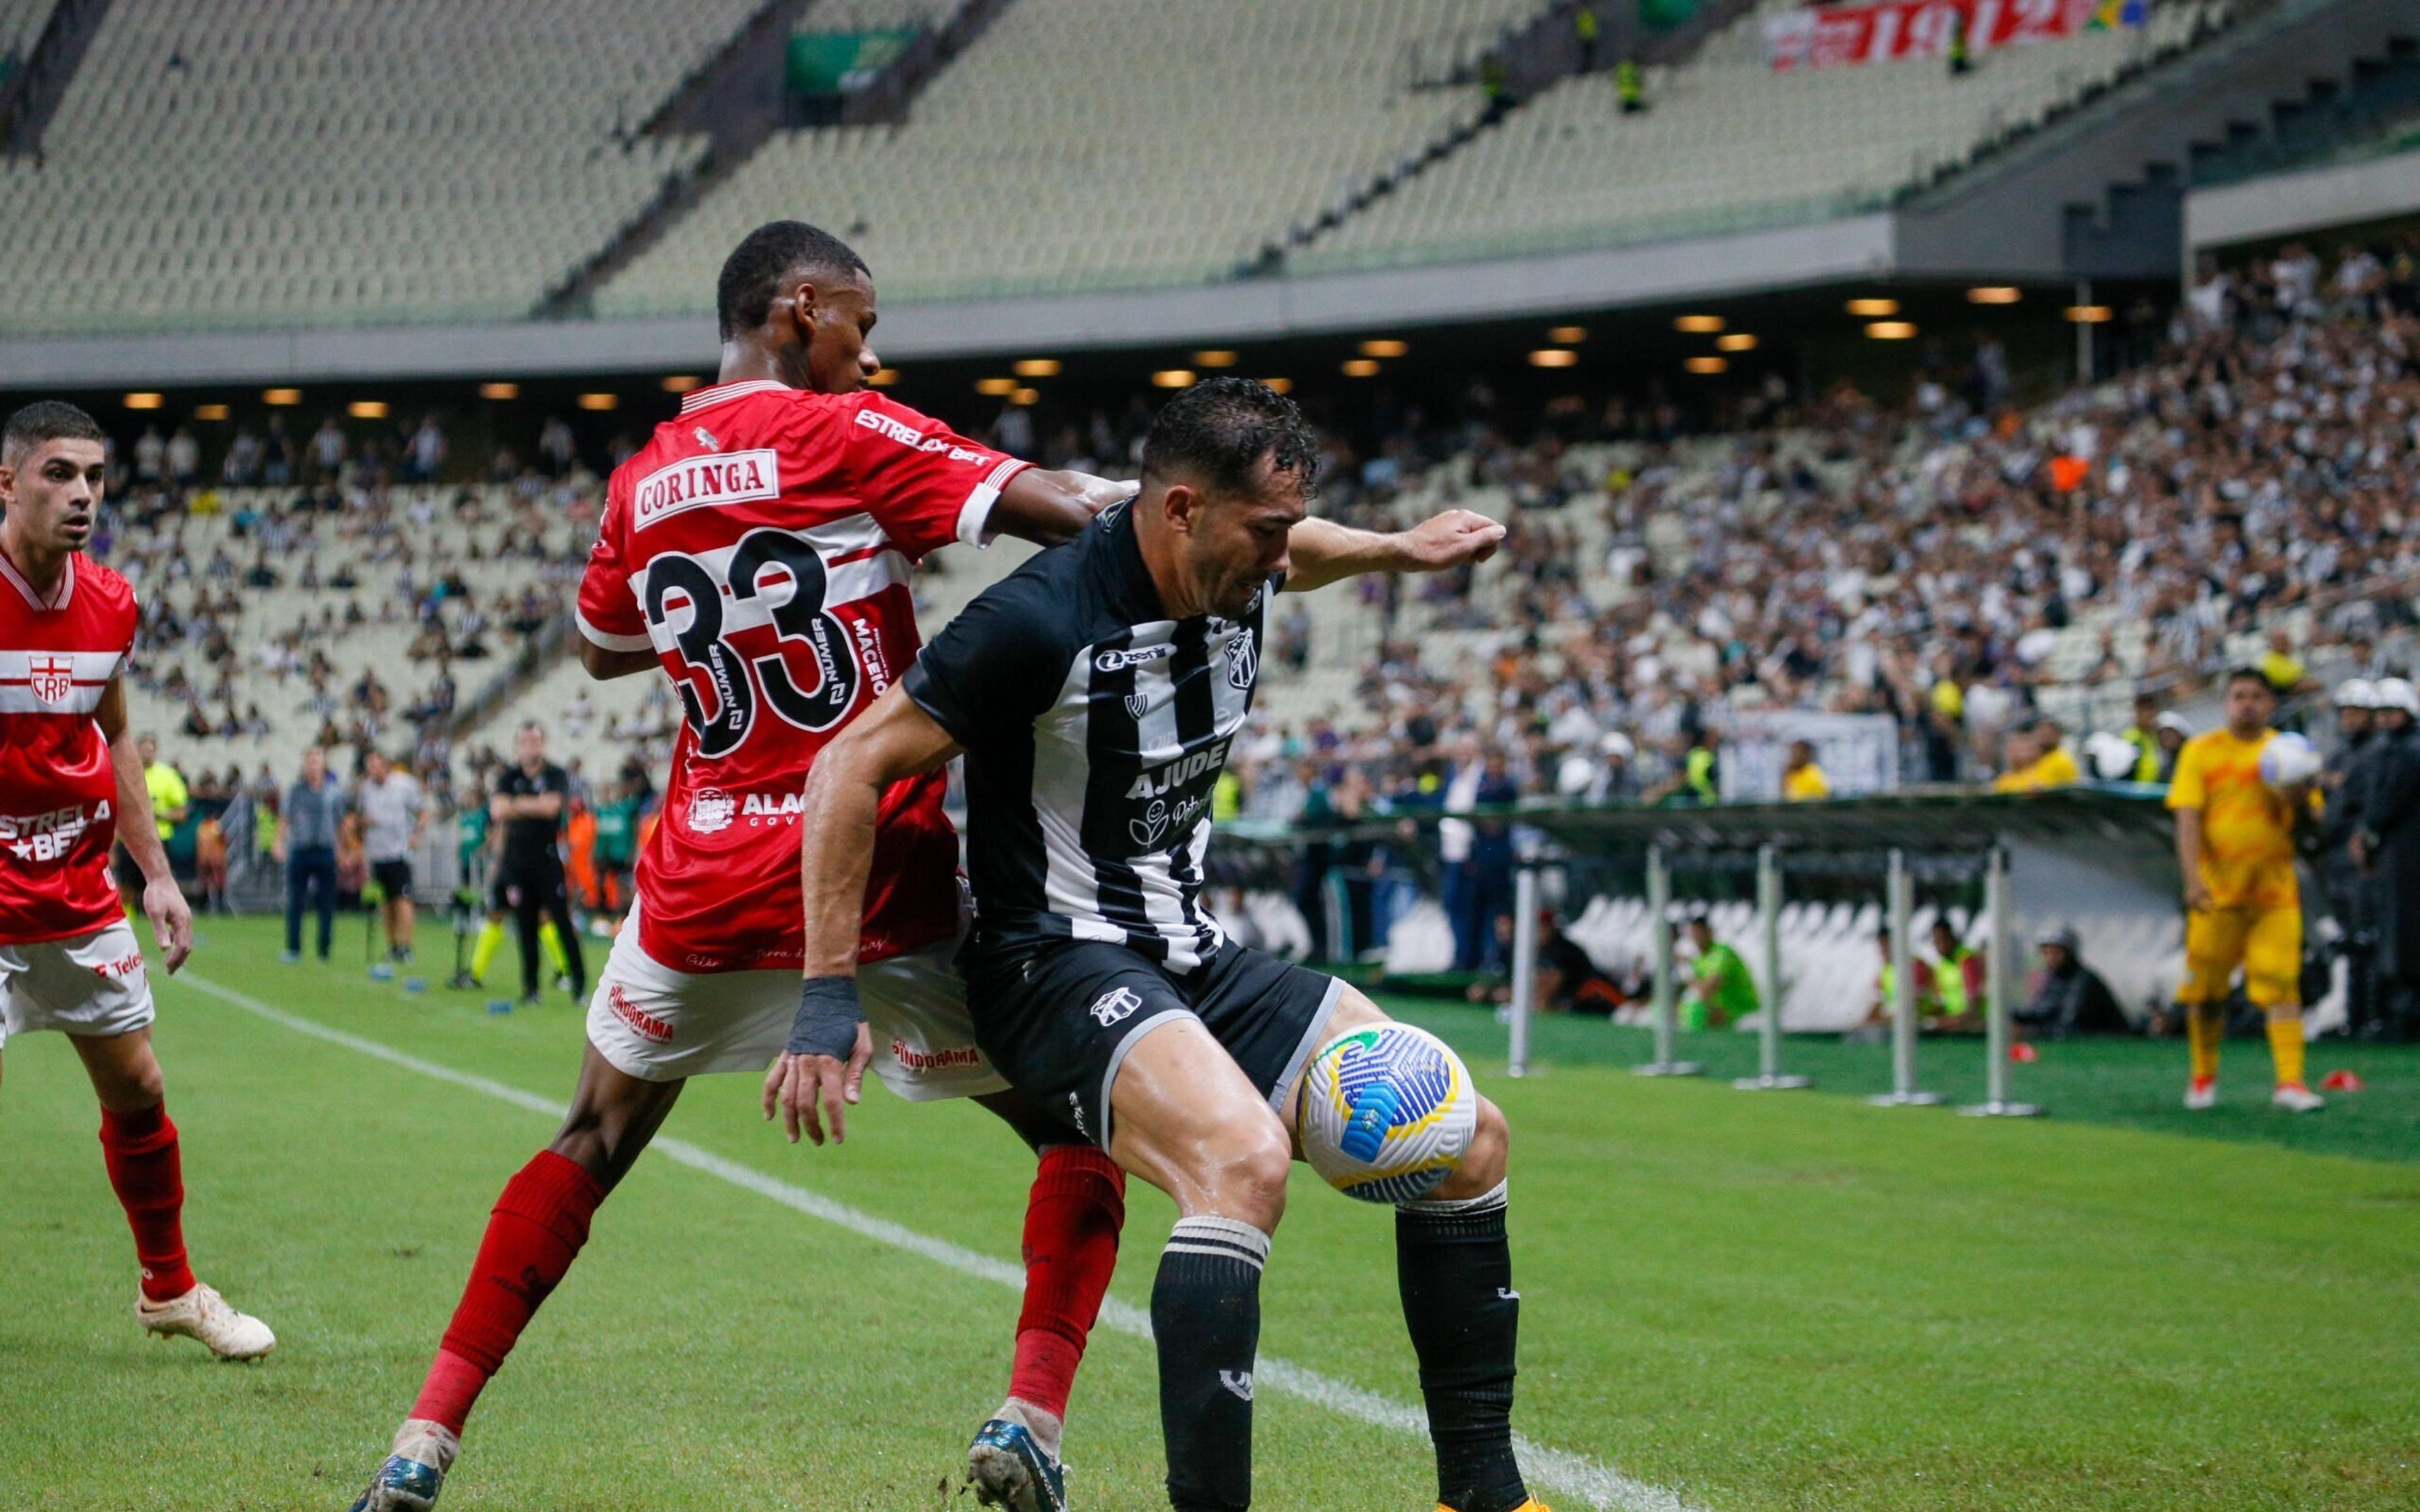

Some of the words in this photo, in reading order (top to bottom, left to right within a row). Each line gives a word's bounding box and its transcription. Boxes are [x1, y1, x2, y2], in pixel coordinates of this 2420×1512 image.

[855, 410, 940, 452] ESTRELA
[948, 446, 991, 466] BET
[640, 461, 764, 515] CORINGA
[645, 527, 861, 759] 33
[811, 617, 838, 682] NUMER
[1125, 647, 1166, 662] zenir
[33, 679, 69, 701] CRB
[708, 644, 737, 707] NUMER
[1125, 742, 1226, 799] AJUDE
[742, 793, 805, 815] ALA
[609, 985, 674, 1040] PINDORAMA
[892, 1045, 979, 1068] PINDORAMA
